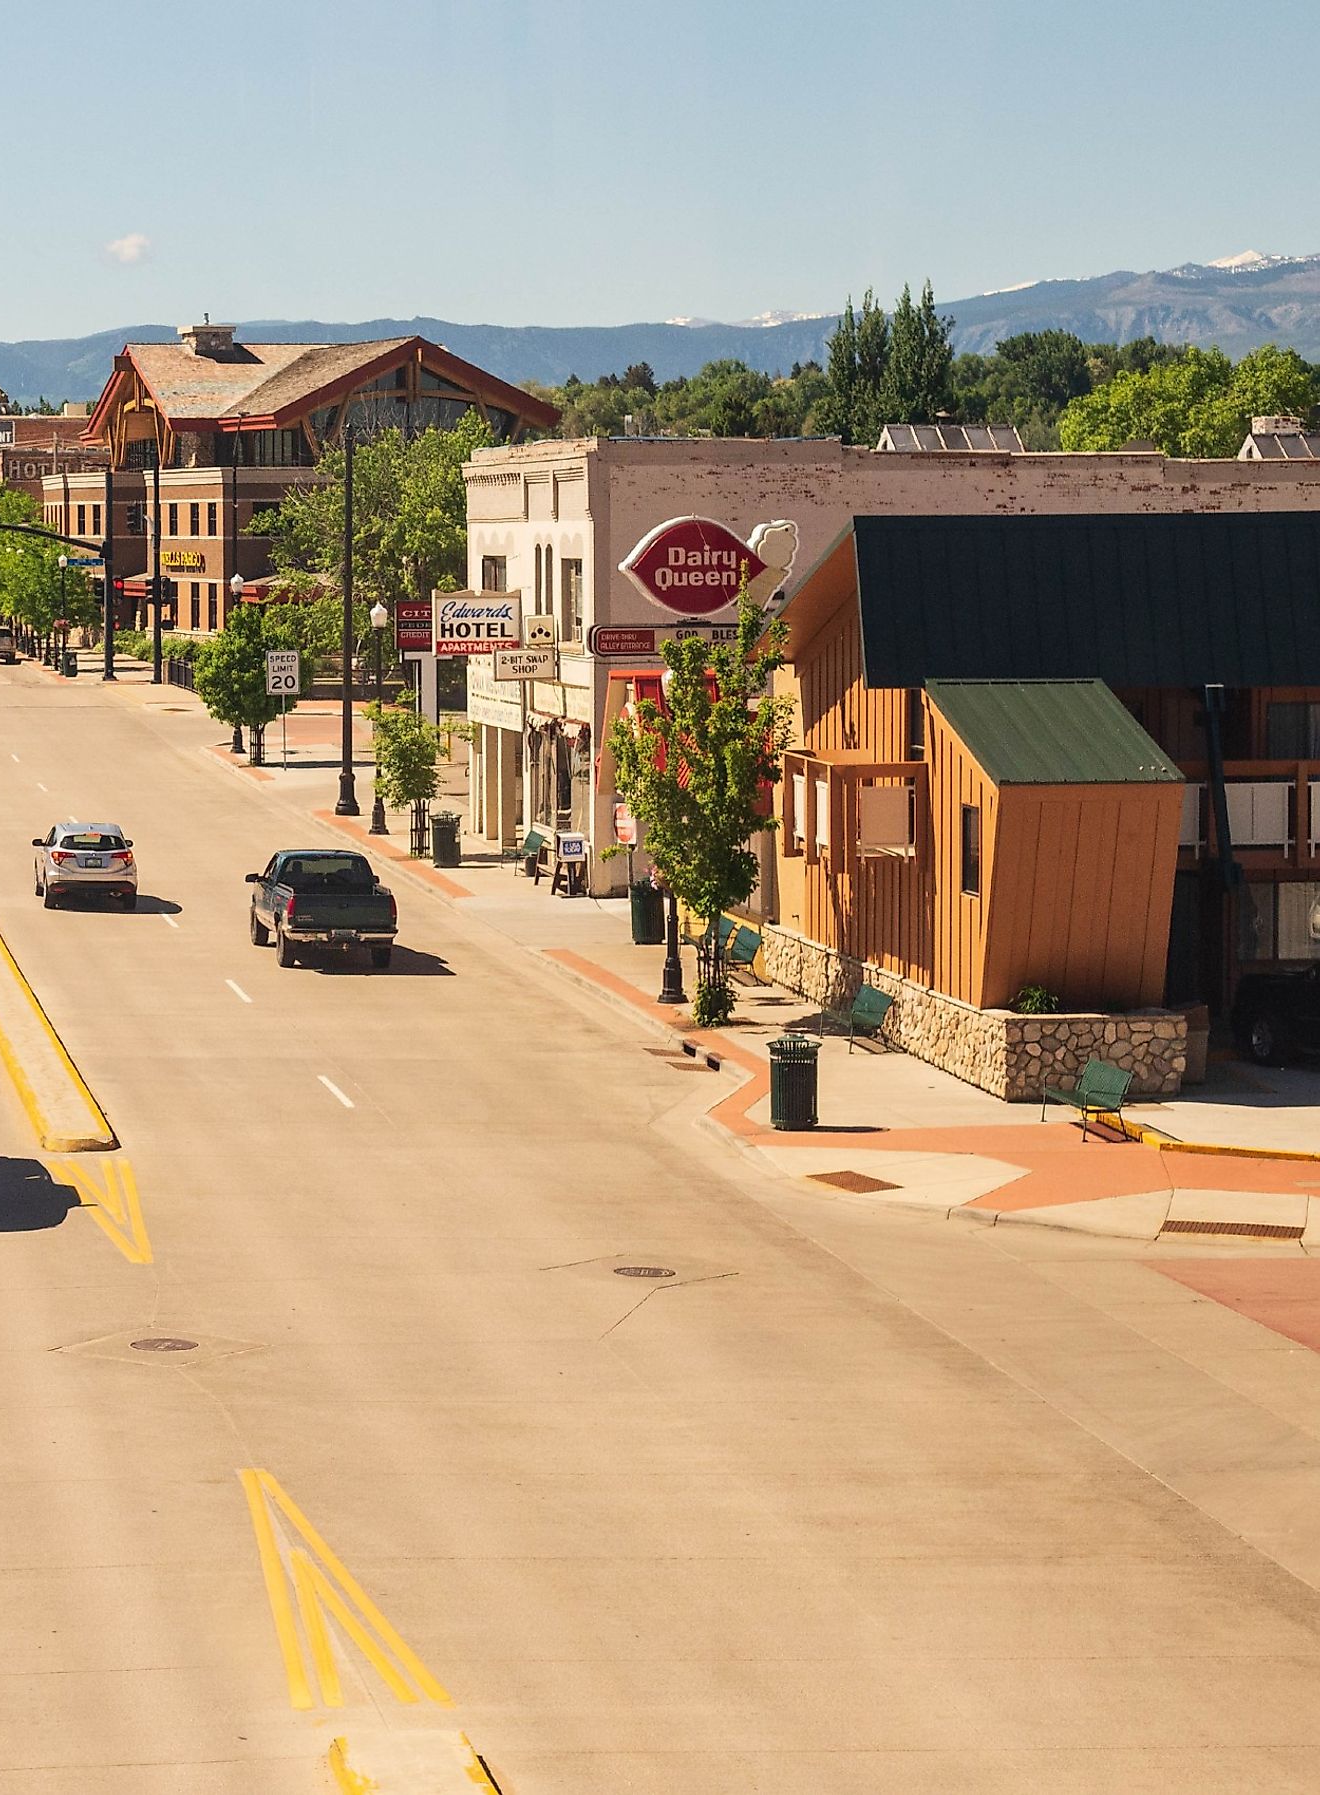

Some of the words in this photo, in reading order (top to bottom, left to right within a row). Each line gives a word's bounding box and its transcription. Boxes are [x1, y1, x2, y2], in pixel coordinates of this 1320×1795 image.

[181, 552, 201, 567] FARGO
[668, 545, 736, 569] Dairy
[655, 568, 736, 590] Queen
[440, 600, 513, 623] Edwards
[440, 622, 513, 638] HOTEL
[676, 629, 699, 640] GOD
[712, 629, 739, 640] BLES
[440, 642, 513, 652] APARTMENTS
[600, 641, 620, 650] ALLEY
[269, 654, 297, 663] SPEED
[525, 654, 549, 664] SWAP
[272, 665, 294, 673] LIMIT
[512, 664, 538, 674] SHOP
[271, 675, 296, 690] 20
